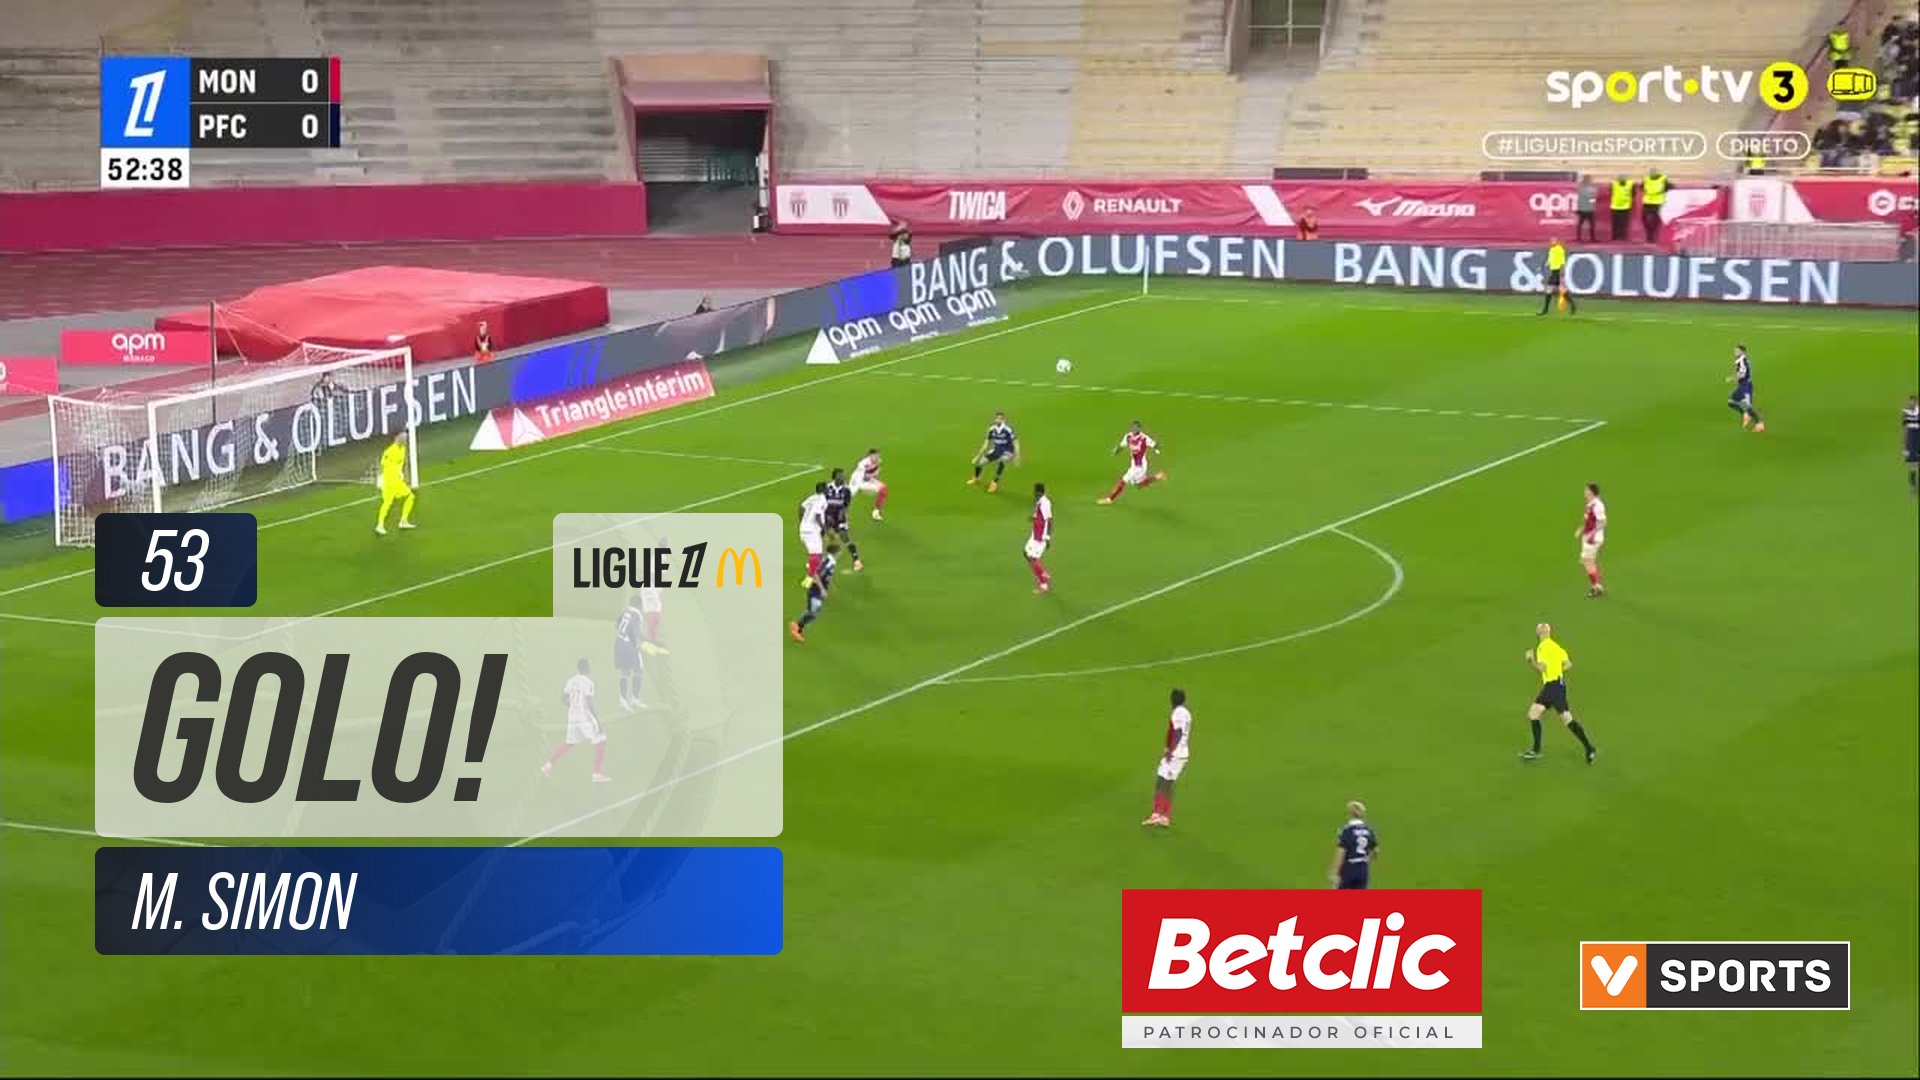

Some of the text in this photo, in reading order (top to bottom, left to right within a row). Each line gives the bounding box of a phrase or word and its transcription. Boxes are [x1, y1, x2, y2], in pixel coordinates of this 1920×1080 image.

[948, 191, 1006, 220] TWIGA
[1094, 199, 1183, 214] RENAULT
[911, 246, 989, 304] BANG
[1037, 234, 1286, 280] OLUFSEN
[1334, 242, 1841, 305] BANG & OLUFSEN
[829, 286, 998, 350] apm apm apm
[111, 332, 166, 355] apm
[104, 420, 235, 500] BANG
[252, 412, 281, 465] &
[1355, 836, 1369, 854] 2
